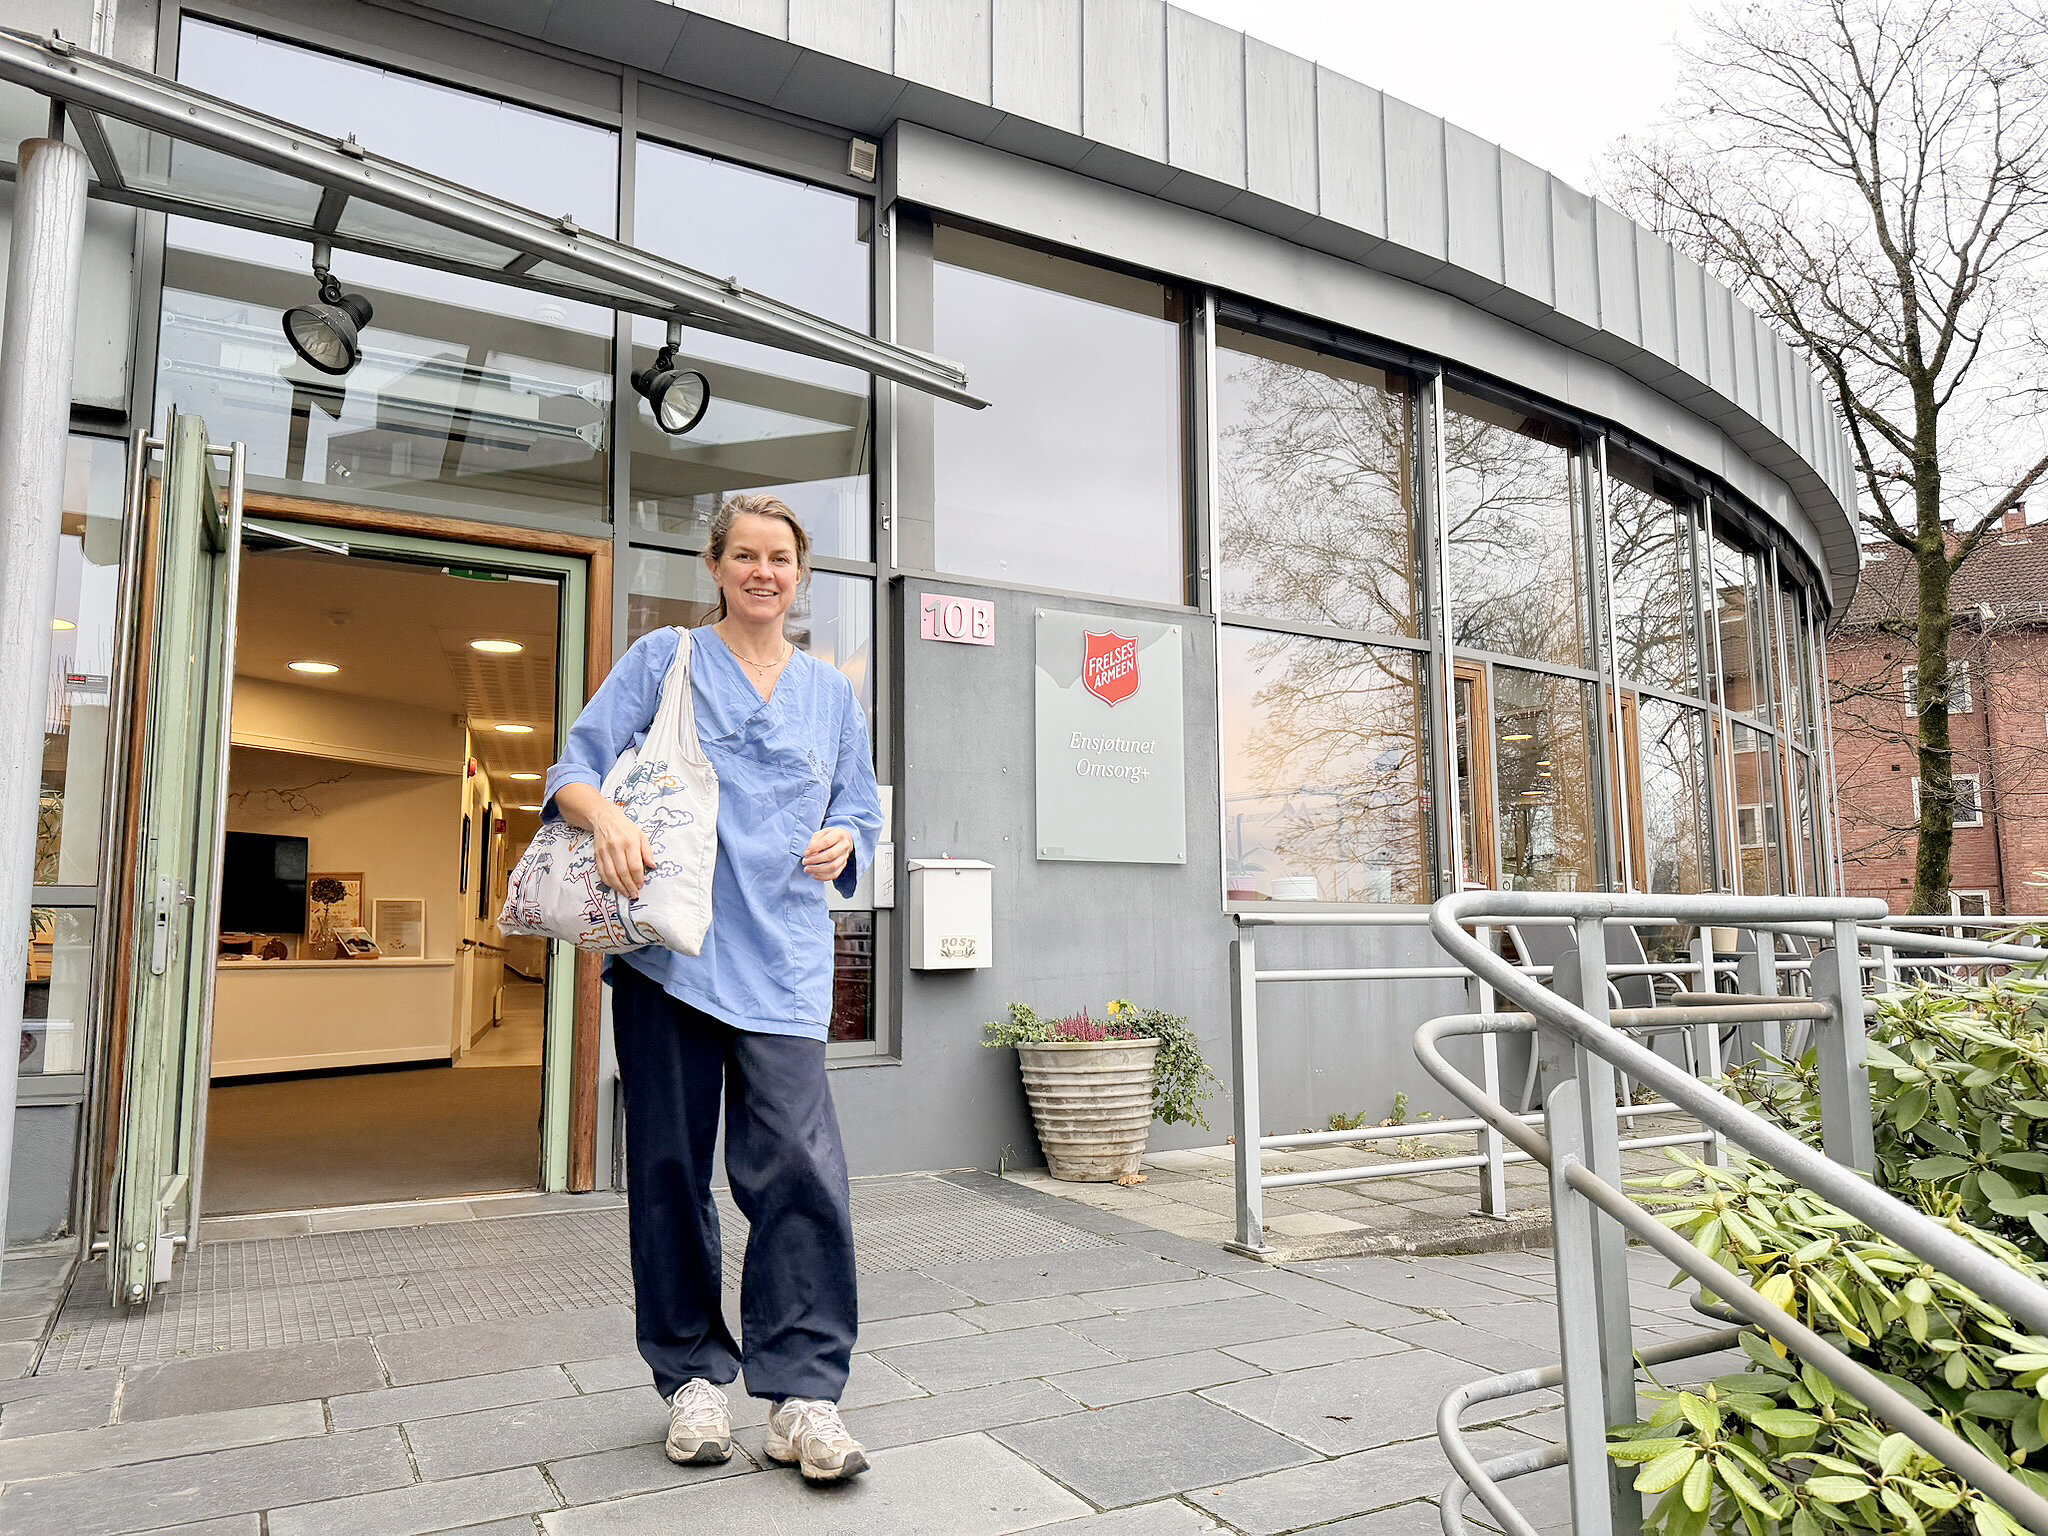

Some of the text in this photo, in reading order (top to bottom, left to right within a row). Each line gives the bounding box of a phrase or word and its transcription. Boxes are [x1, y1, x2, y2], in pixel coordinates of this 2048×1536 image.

[1094, 657, 1134, 689] ARMEEN
[1069, 731, 1156, 754] Ensjøtunet
[1076, 758, 1150, 783] Omsorg+
[941, 937, 976, 948] POST
